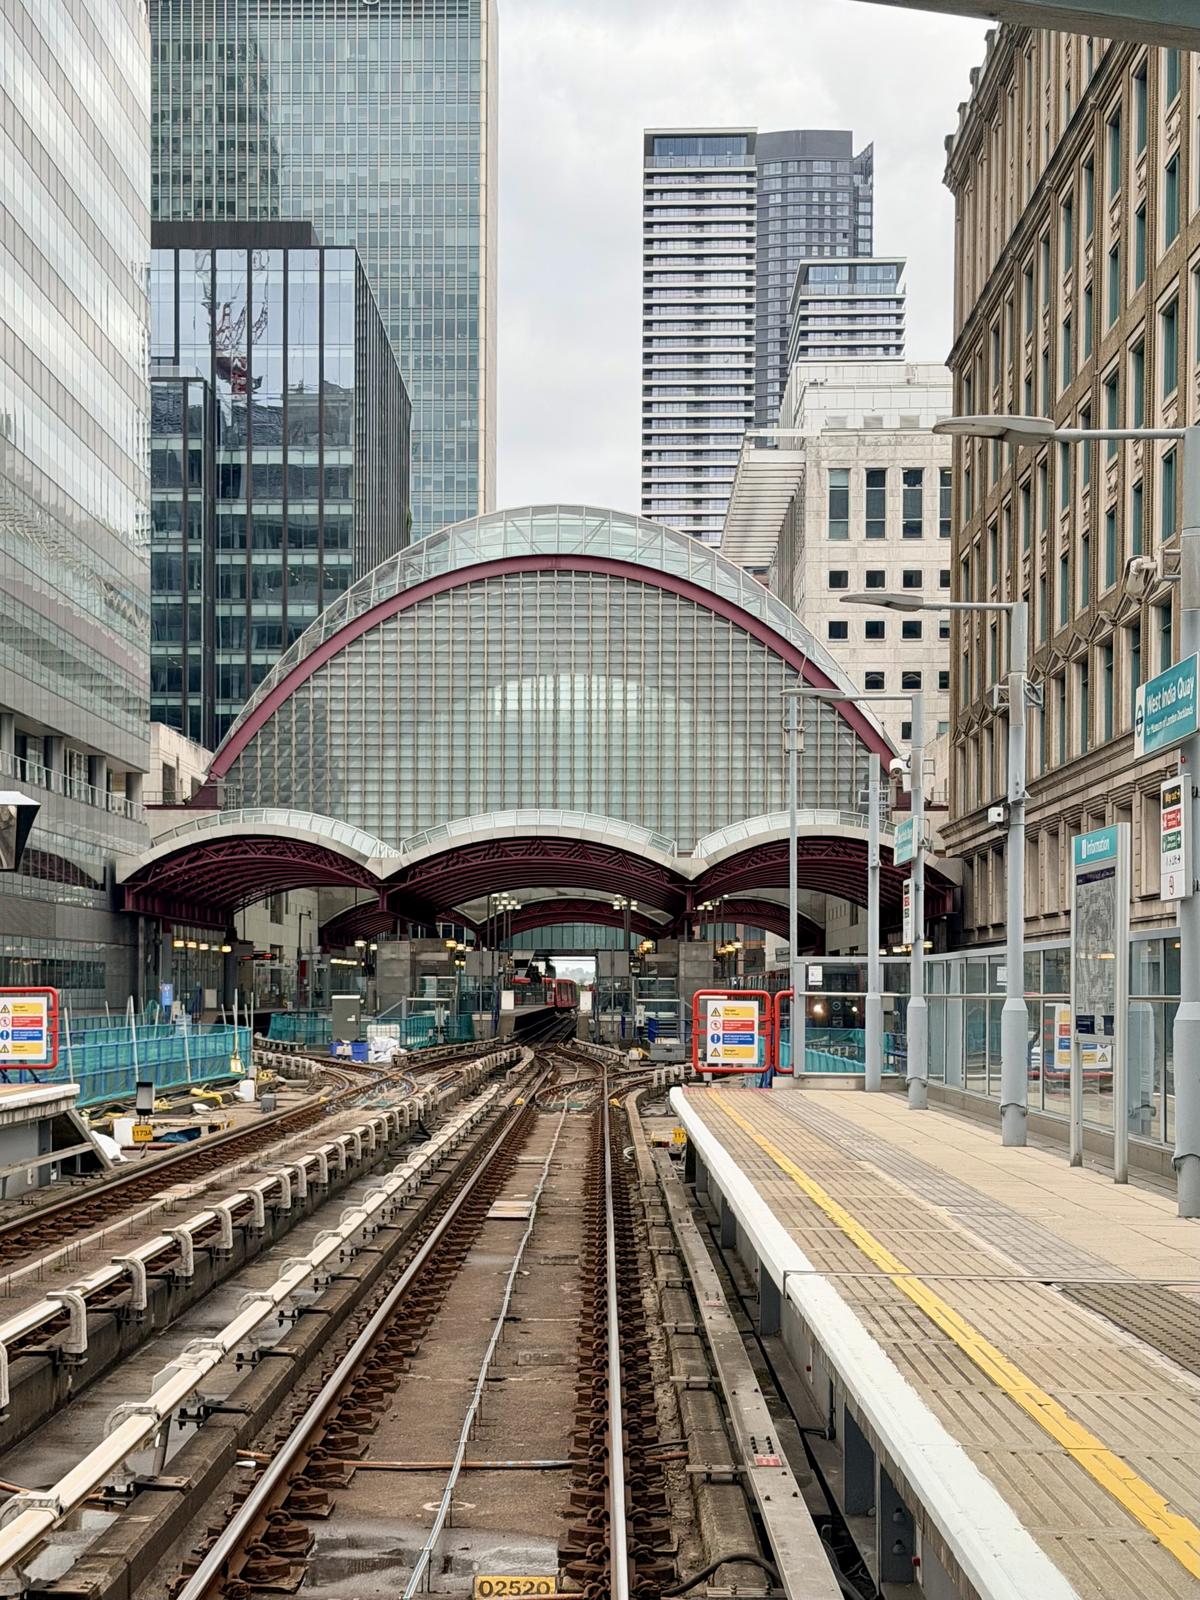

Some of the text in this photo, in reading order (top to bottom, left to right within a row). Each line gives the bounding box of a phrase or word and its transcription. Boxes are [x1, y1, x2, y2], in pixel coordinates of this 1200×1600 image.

[1146, 676, 1195, 716] West India Quay
[479, 1580, 551, 1598] 02520
